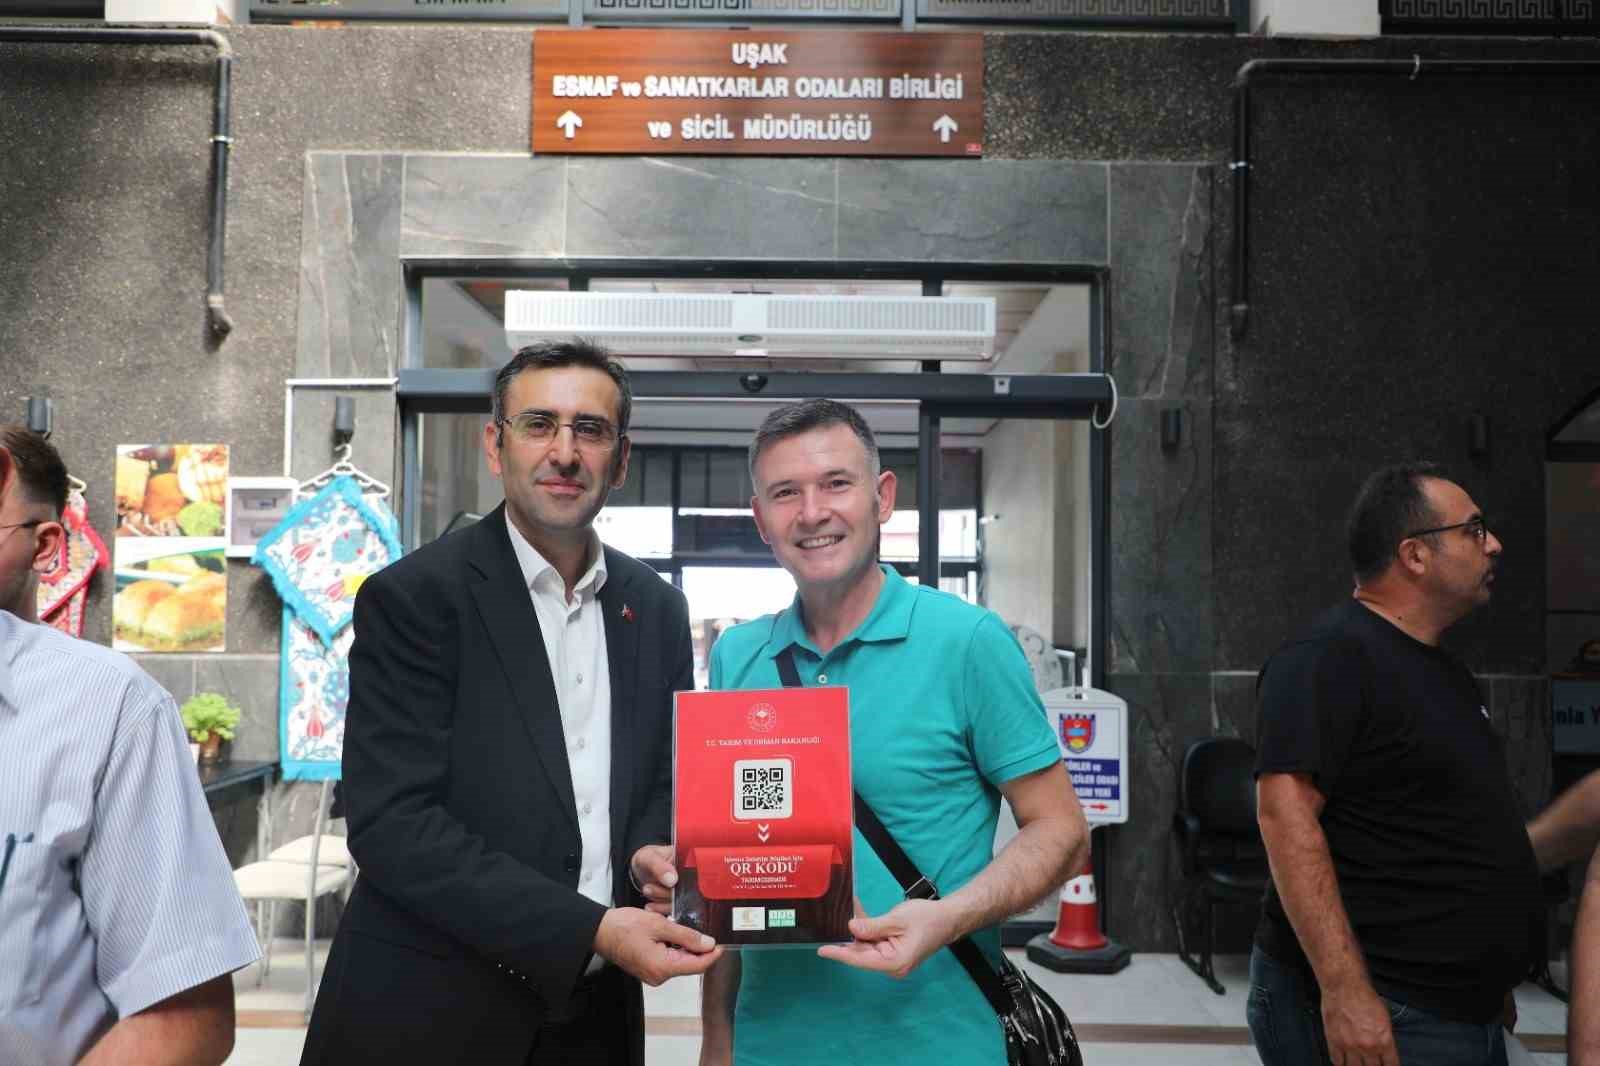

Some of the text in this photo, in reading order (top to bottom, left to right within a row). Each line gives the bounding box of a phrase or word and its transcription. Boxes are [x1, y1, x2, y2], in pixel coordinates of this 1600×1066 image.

[732, 42, 788, 69] UŞAK
[553, 75, 619, 97] ESNAF
[621, 81, 642, 97] ve
[644, 75, 789, 98] SANATKARLAR
[795, 76, 883, 99] ODALARI
[648, 113, 872, 141] ve SİCİL MÜDÜRLÜĞÜ
[730, 861, 797, 876] QR KODU
